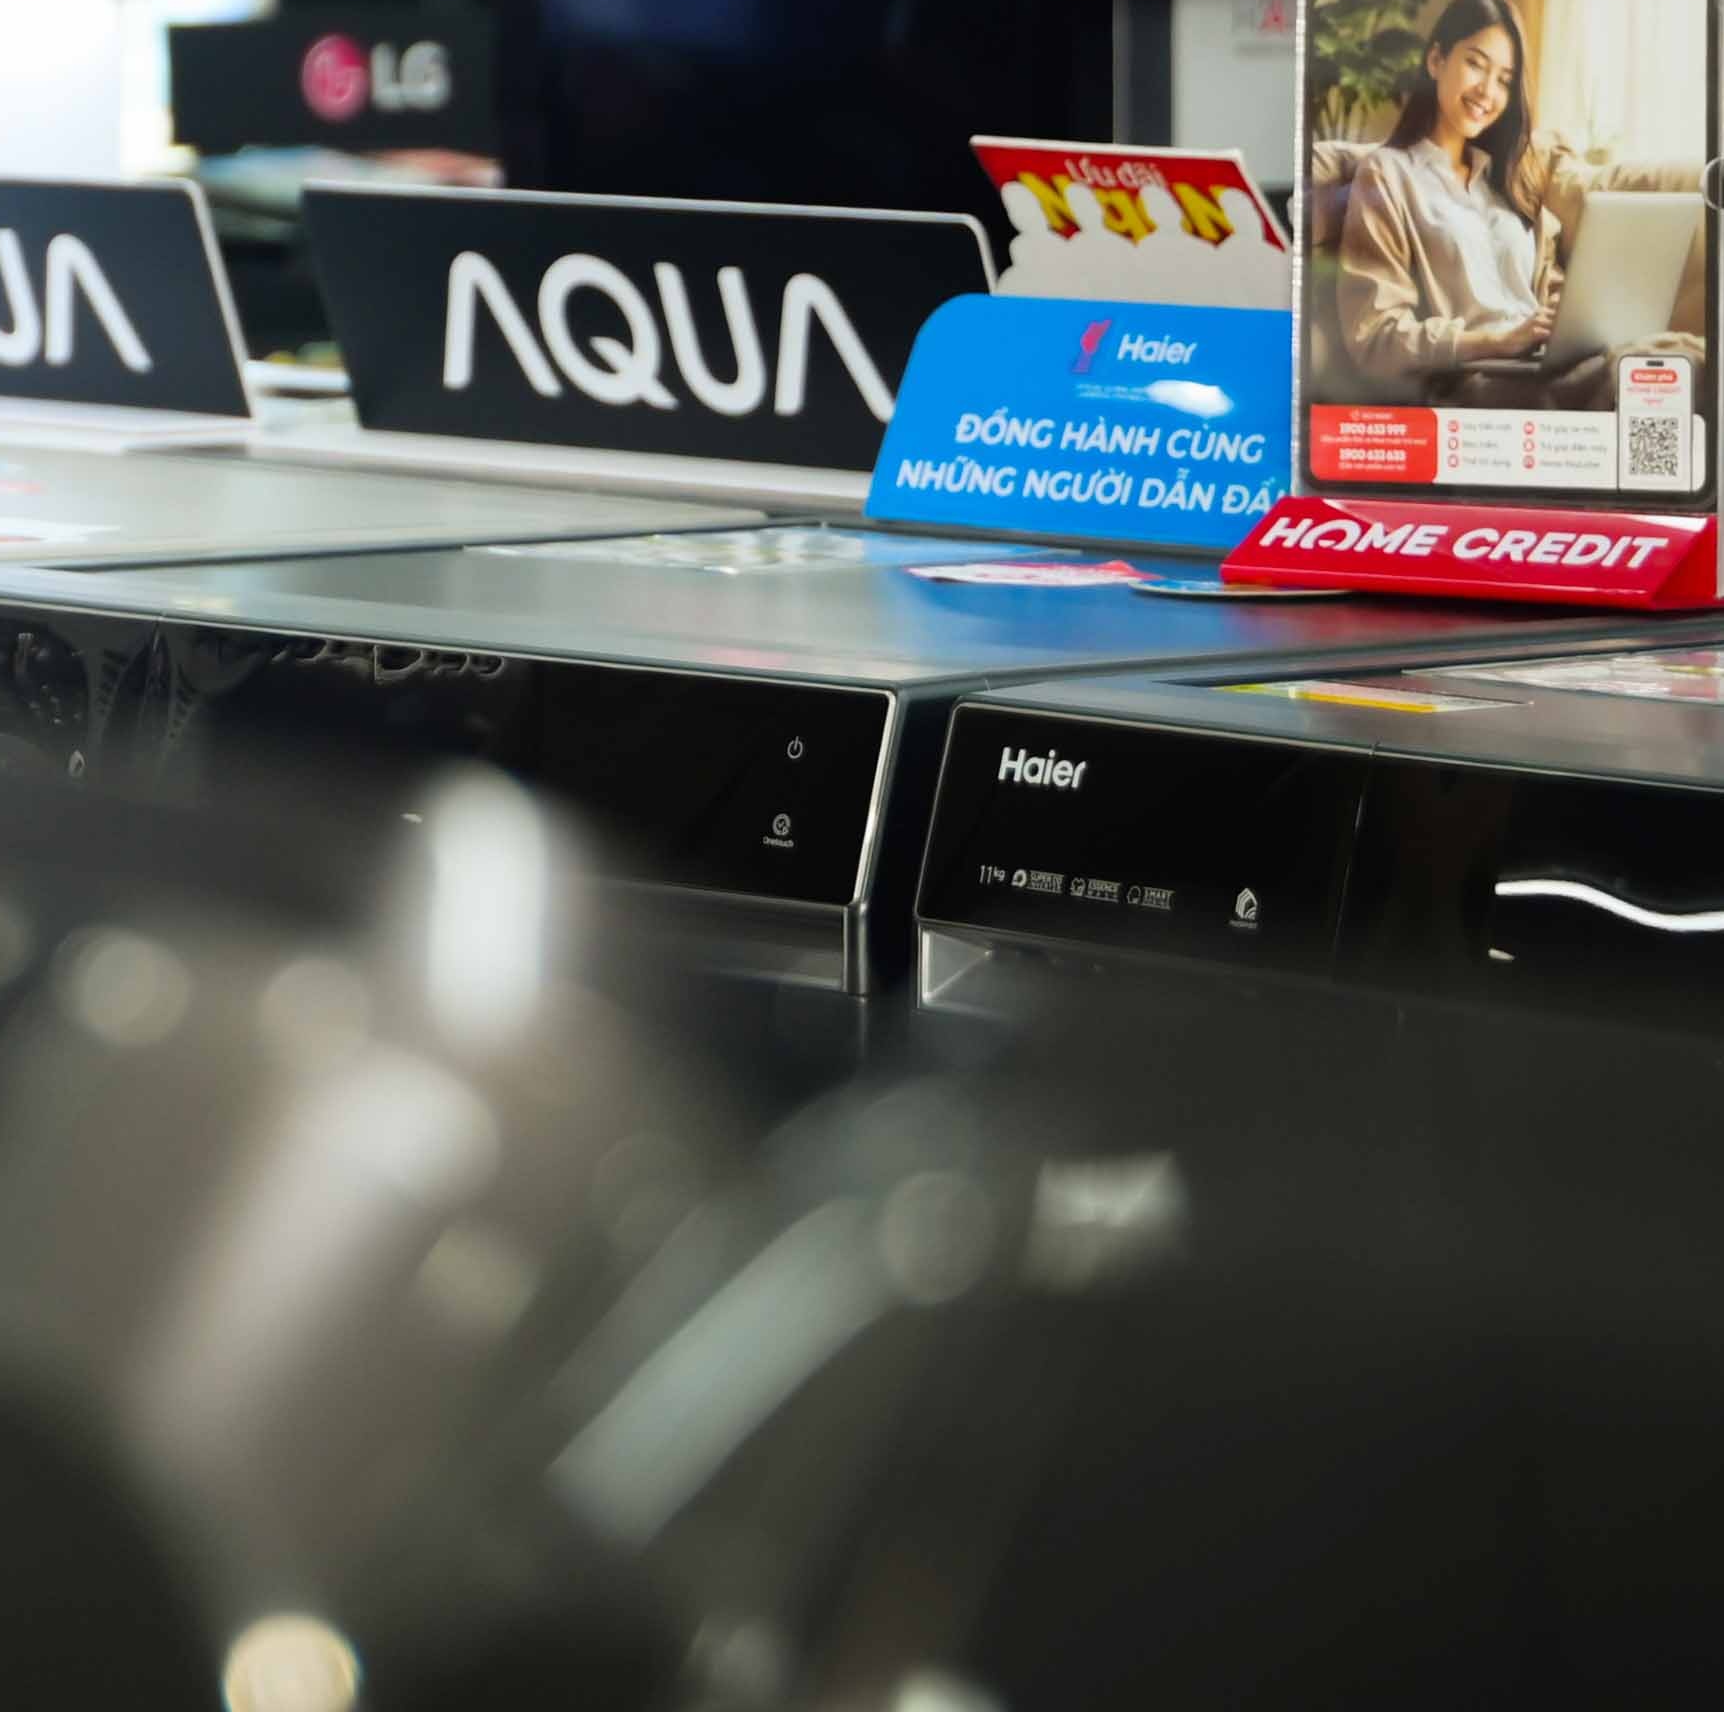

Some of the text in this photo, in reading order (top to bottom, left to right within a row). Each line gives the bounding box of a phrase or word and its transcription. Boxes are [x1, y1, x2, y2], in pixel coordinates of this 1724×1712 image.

[370, 40, 452, 110] LG
[442, 250, 895, 424] AQUA
[1117, 334, 1197, 364] Haier
[955, 406, 1265, 464] ĐỒNG HÀNH CÙNG
[896, 455, 1017, 497] NHỮNG
[1023, 466, 1133, 506] NGƯỜI
[1138, 468, 1215, 514] DẪN
[1258, 515, 1669, 569] HOME CREDIT
[997, 747, 1086, 790] Haier
